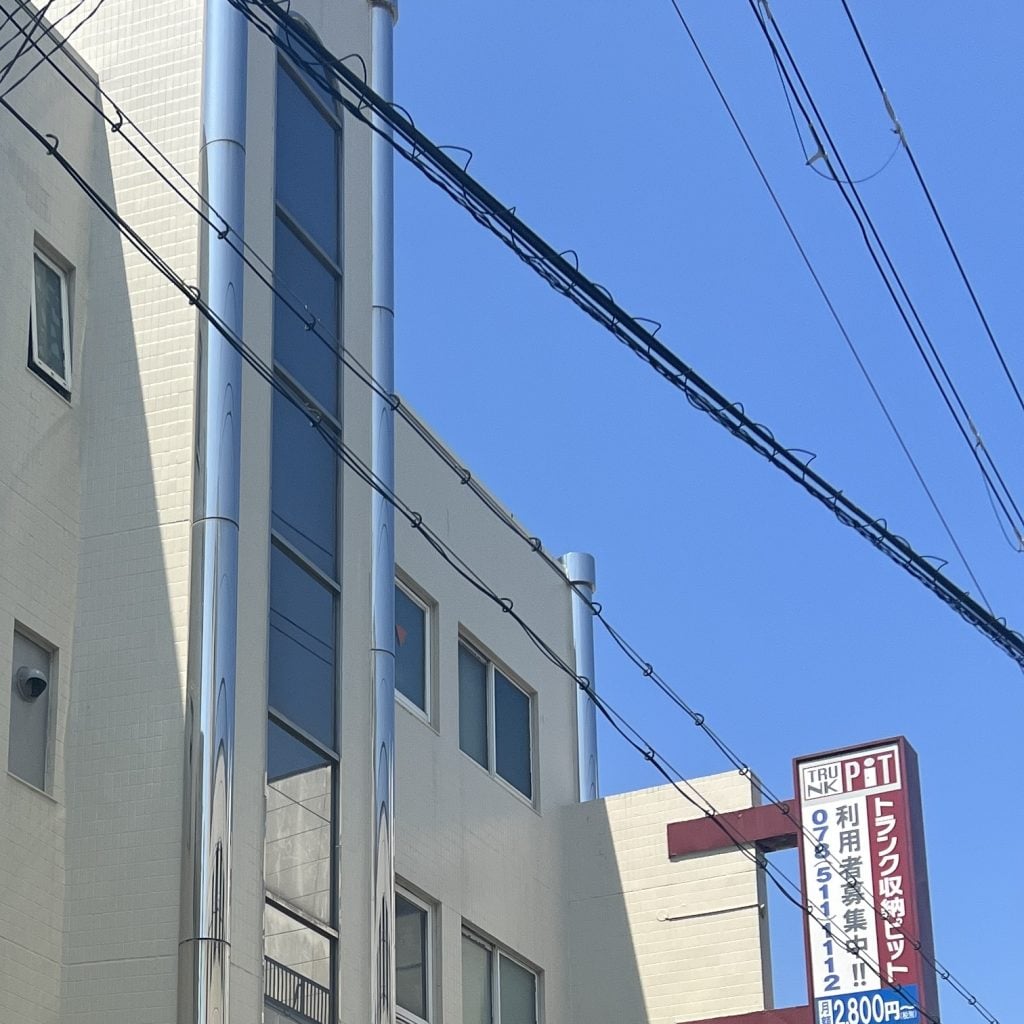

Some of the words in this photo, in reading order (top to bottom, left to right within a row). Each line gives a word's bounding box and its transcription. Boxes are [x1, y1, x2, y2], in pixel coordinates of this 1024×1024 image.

[875, 797, 909, 983] トランク収納ピット
